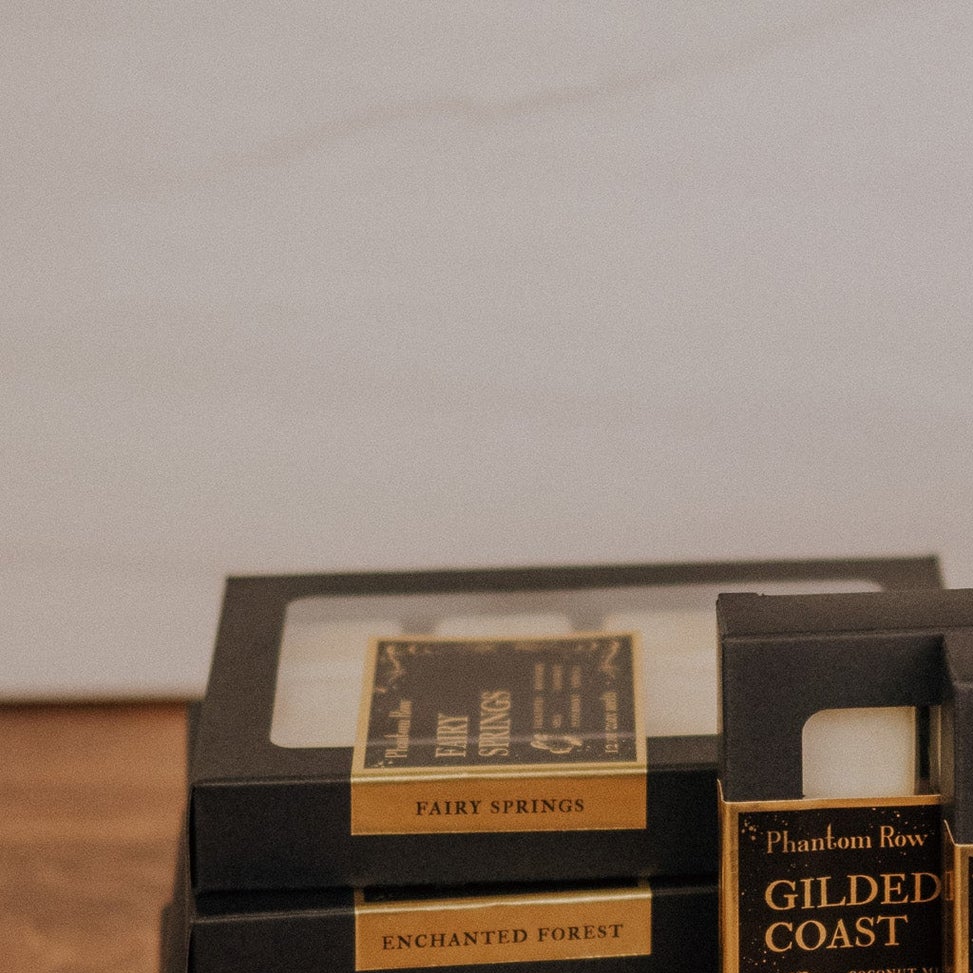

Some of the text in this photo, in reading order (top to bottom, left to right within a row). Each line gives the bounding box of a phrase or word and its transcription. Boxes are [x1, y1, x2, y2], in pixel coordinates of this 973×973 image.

[435, 713, 468, 757] FAIRY
[478, 690, 511, 756] SPRINGS
[416, 799, 585, 816] FAIRY SPRINGS
[767, 824, 929, 854] Phantom Row
[765, 872, 941, 911] GILDED
[382, 924, 625, 950] ENCHANTED FOREST
[765, 915, 908, 952] COAST
